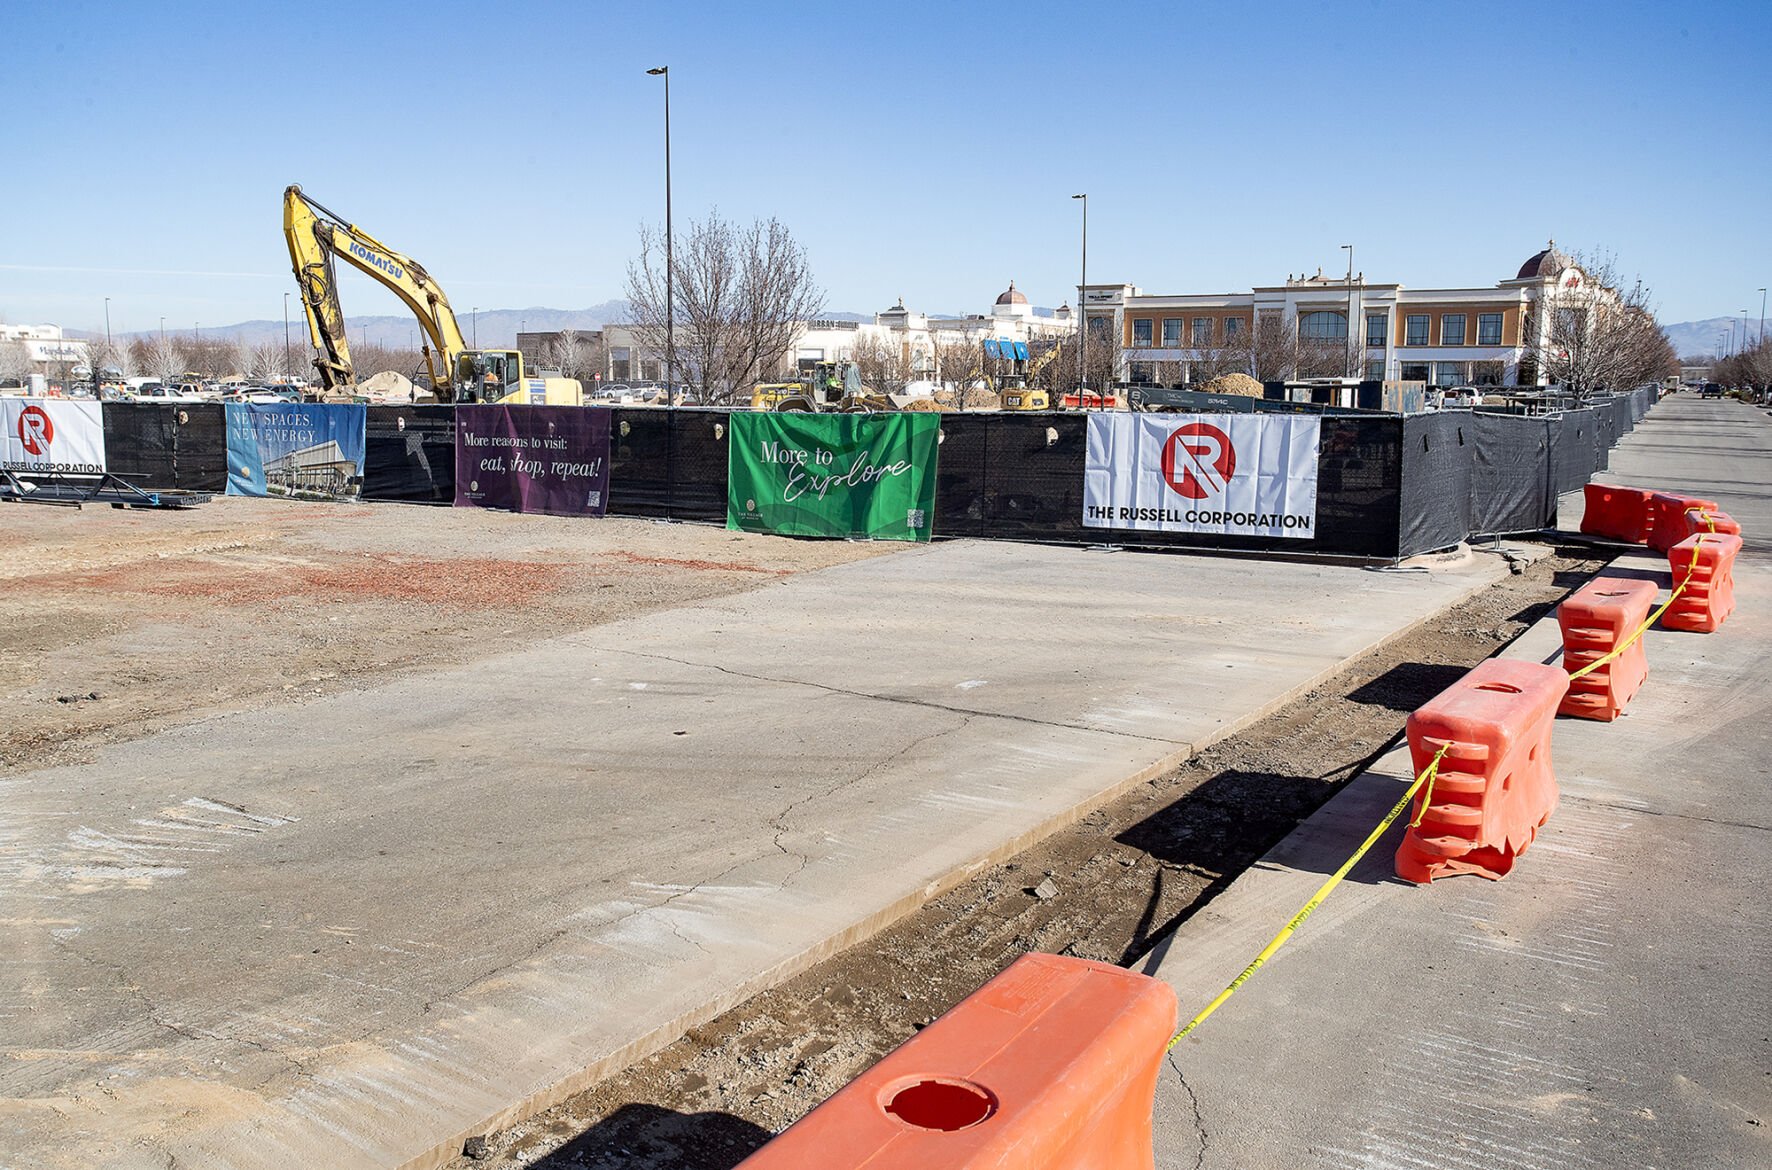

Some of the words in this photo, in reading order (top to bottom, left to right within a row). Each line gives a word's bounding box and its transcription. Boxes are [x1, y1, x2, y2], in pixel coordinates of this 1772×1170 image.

[349, 242, 403, 279] KOMATSU
[1007, 396, 1021, 406] CAT
[233, 412, 258, 425] NEW
[263, 413, 314, 426] SPACES.
[233, 428, 258, 440] NEW
[265, 429, 318, 443] ENERGY.
[464, 432, 489, 447] More
[491, 436, 529, 448] reasons
[531, 437, 541, 449] to
[543, 435, 568, 450] visit:
[760, 440, 808, 464] More
[815, 447, 833, 465] to
[3, 461, 32, 470] RUSSELL
[33, 462, 103, 473] CORPORATION
[480, 456, 506, 474] eat,
[510, 452, 546, 479] shop,
[551, 457, 602, 481] repeat!
[783, 450, 912, 502] Explore
[1088, 505, 1114, 520] THE
[1119, 507, 1182, 523] RUSSELL
[1185, 510, 1310, 529] CORPORATION
